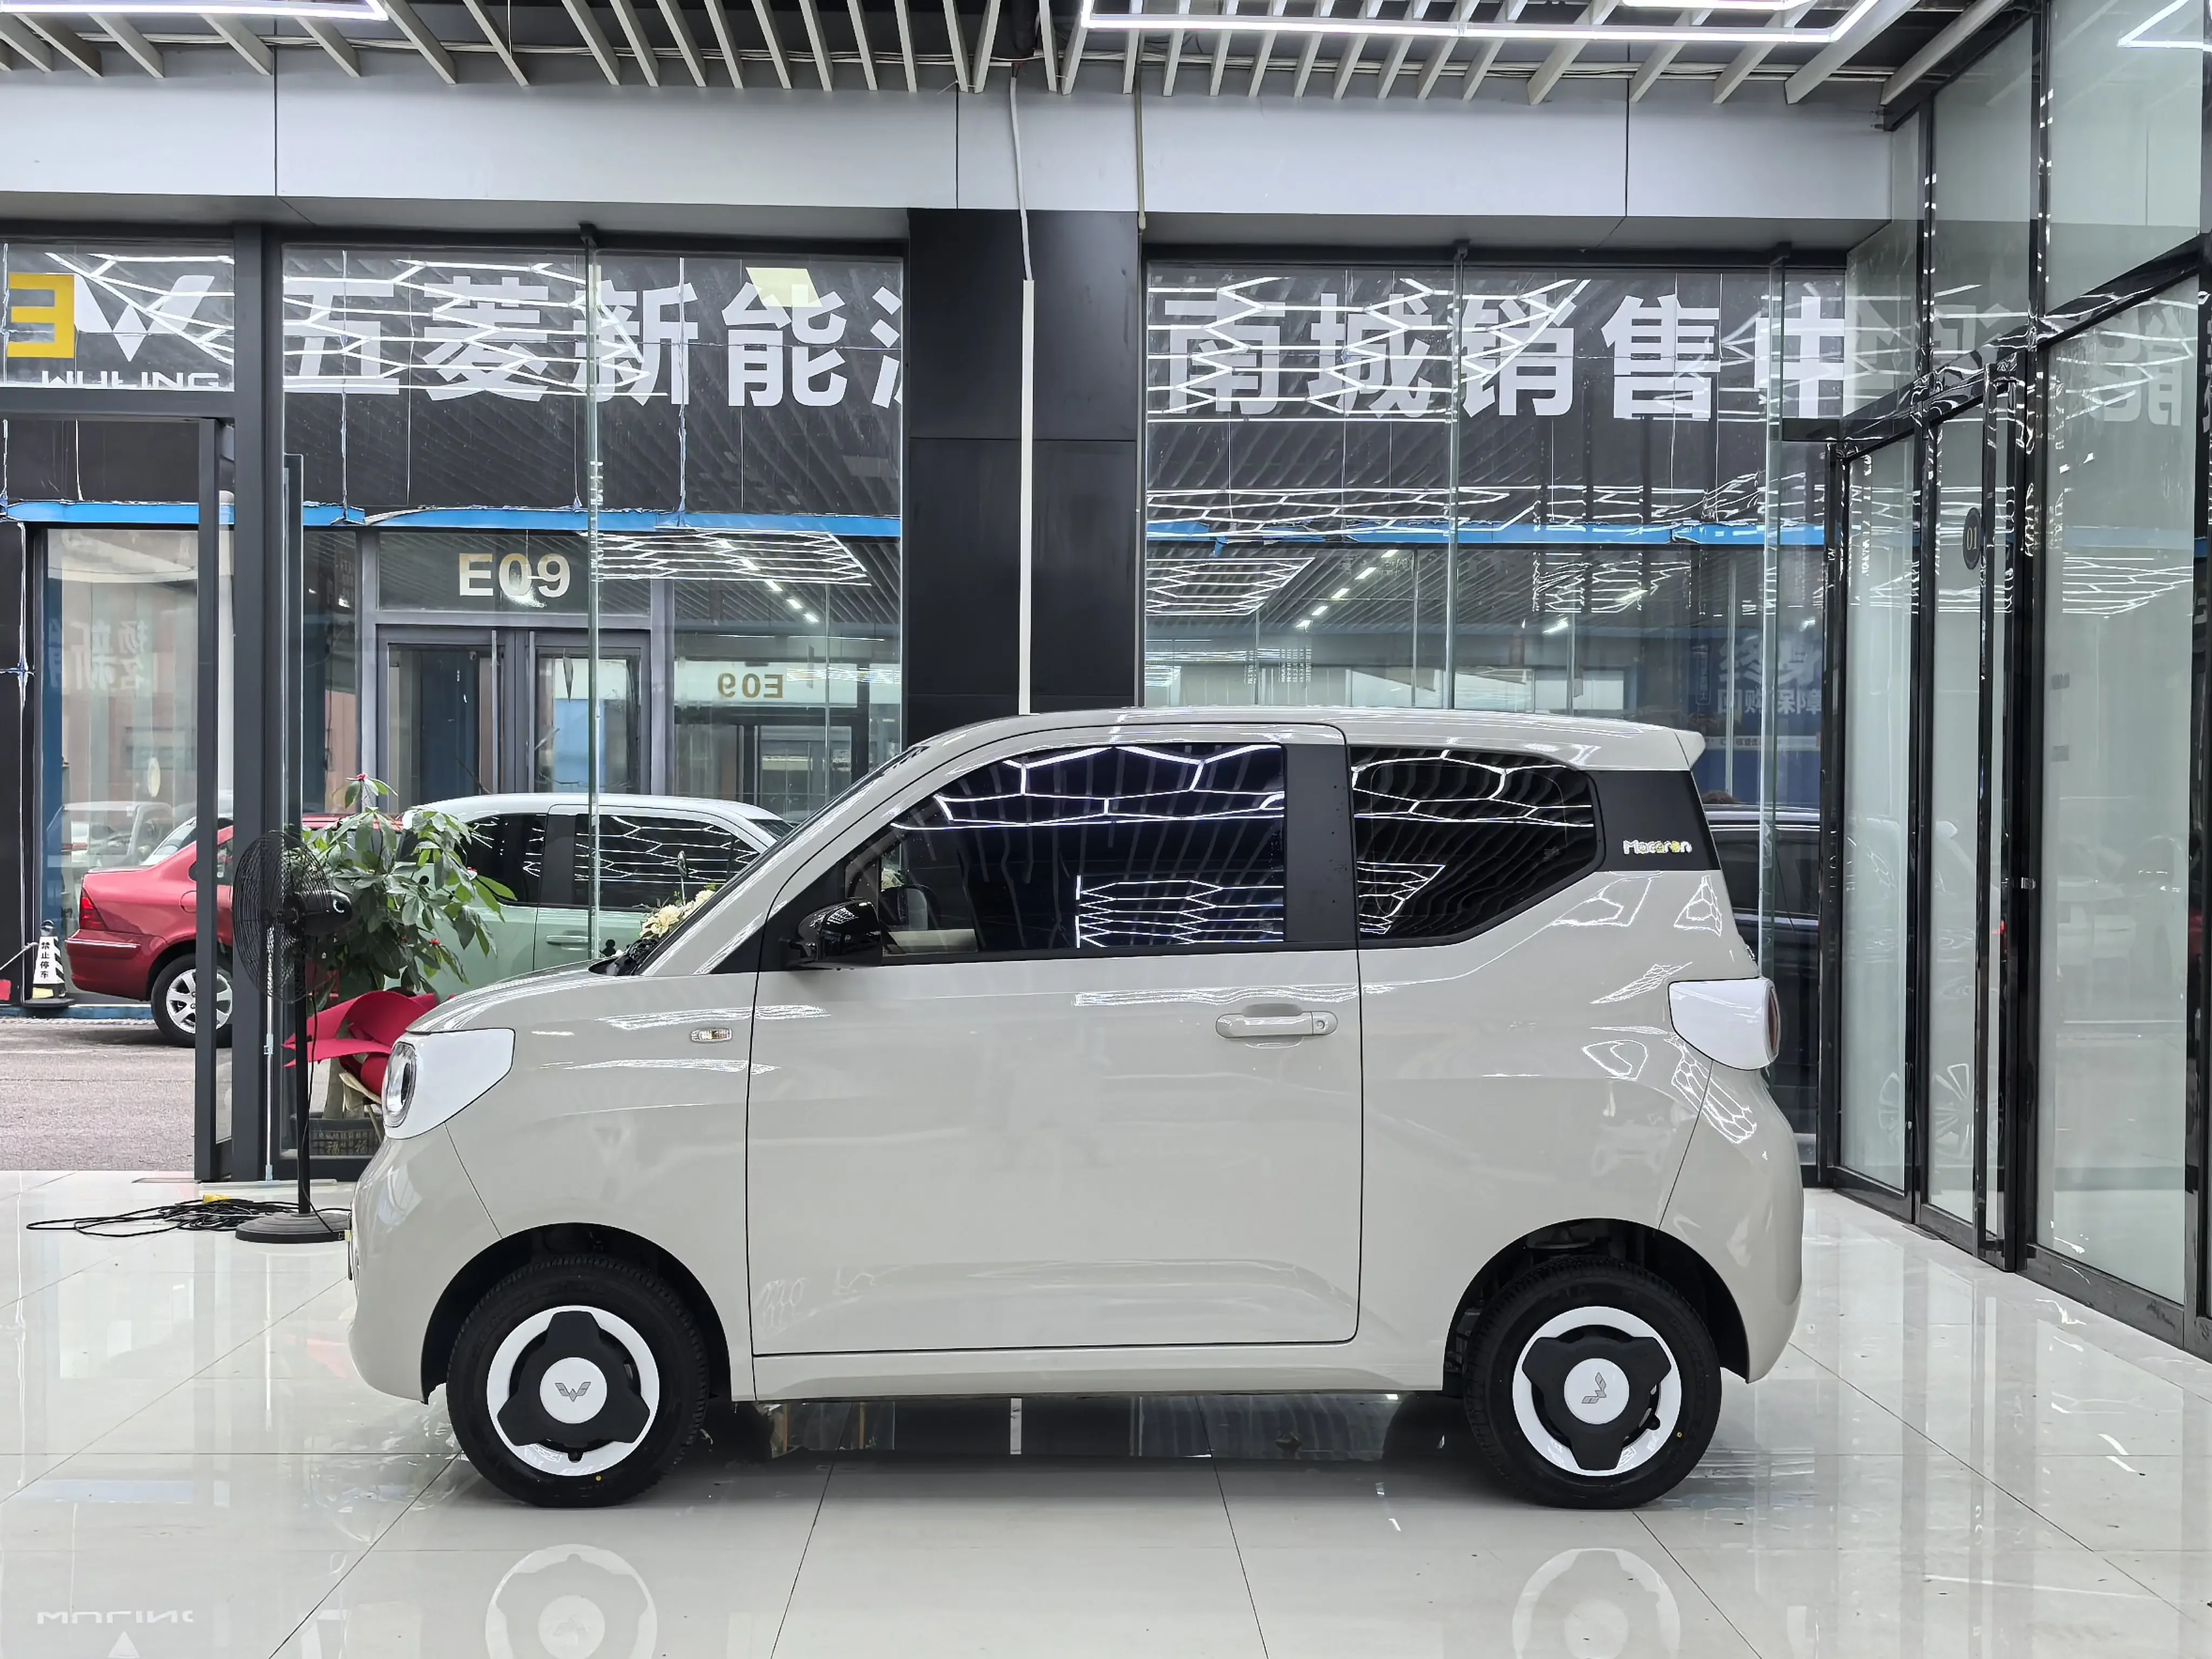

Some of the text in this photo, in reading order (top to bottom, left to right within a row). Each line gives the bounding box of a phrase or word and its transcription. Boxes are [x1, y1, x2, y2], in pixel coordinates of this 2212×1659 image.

[458, 552, 571, 598] E09
[1623, 839, 1692, 854] Macaron
[40, 942, 50, 979] 禁止停车
